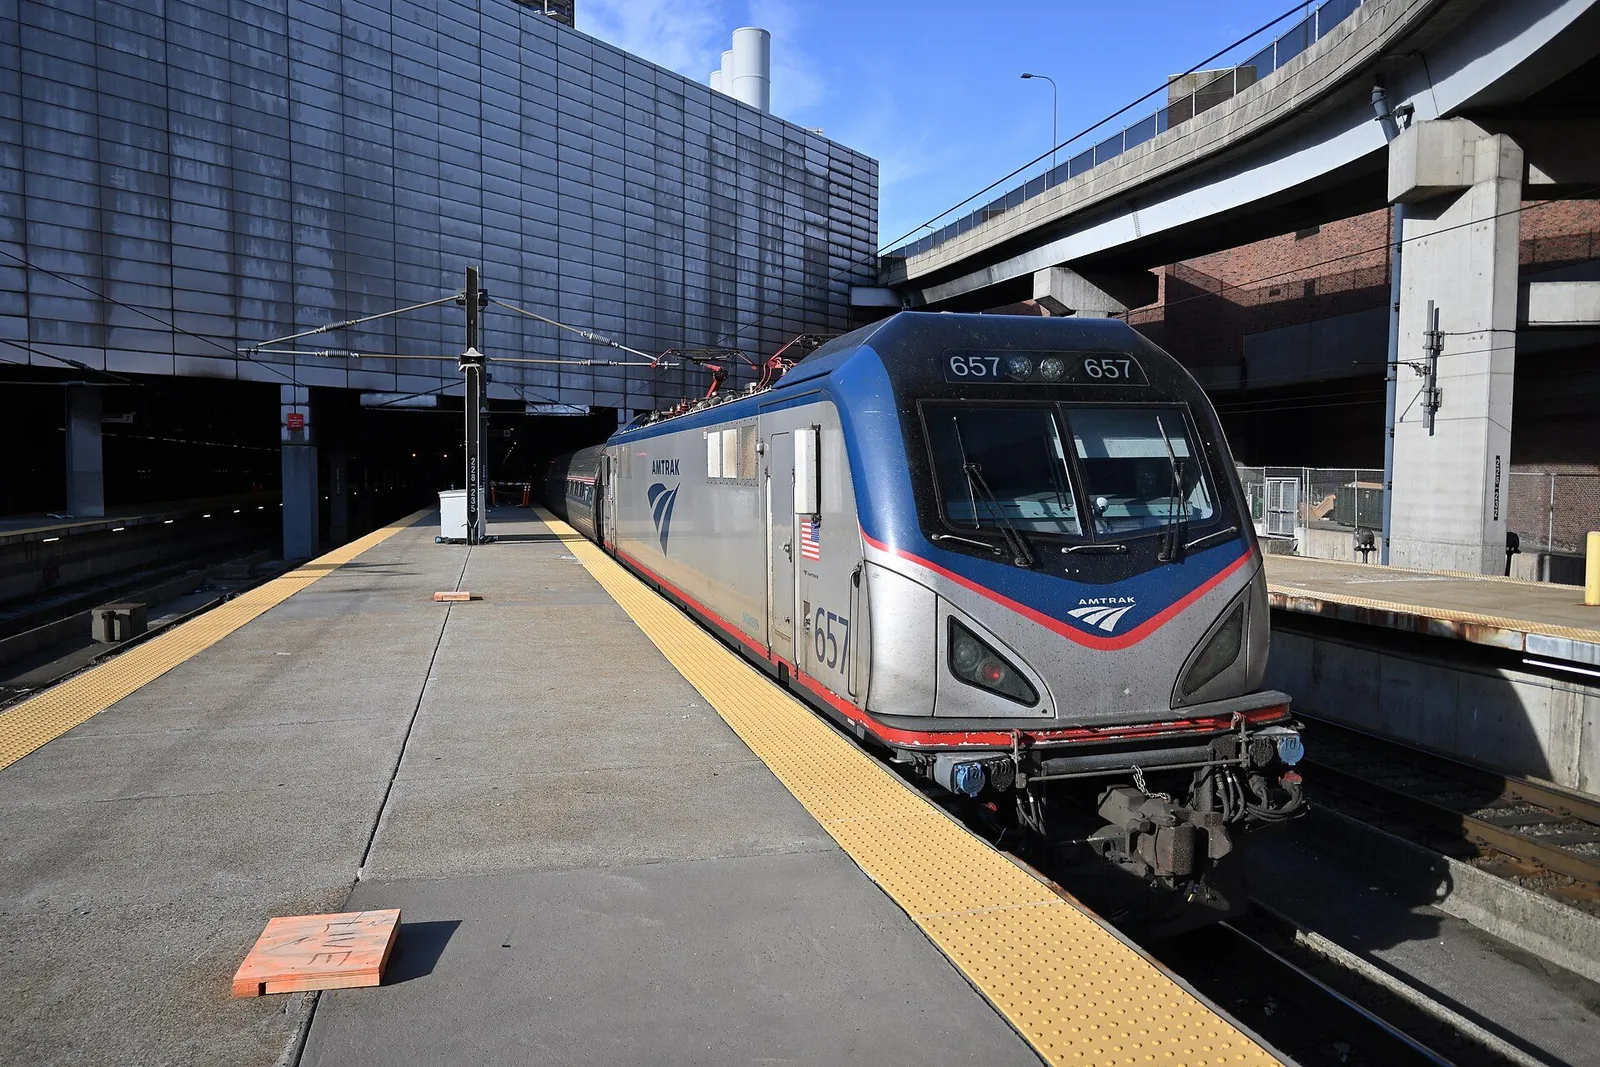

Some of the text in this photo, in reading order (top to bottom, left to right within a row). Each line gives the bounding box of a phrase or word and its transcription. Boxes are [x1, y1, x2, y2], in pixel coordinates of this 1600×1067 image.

[950, 356, 1000, 376] 657
[1084, 358, 1131, 379] 657
[651, 459, 680, 476] AMTRAK
[1078, 596, 1136, 605] AMTRAK
[815, 607, 849, 675] 657
